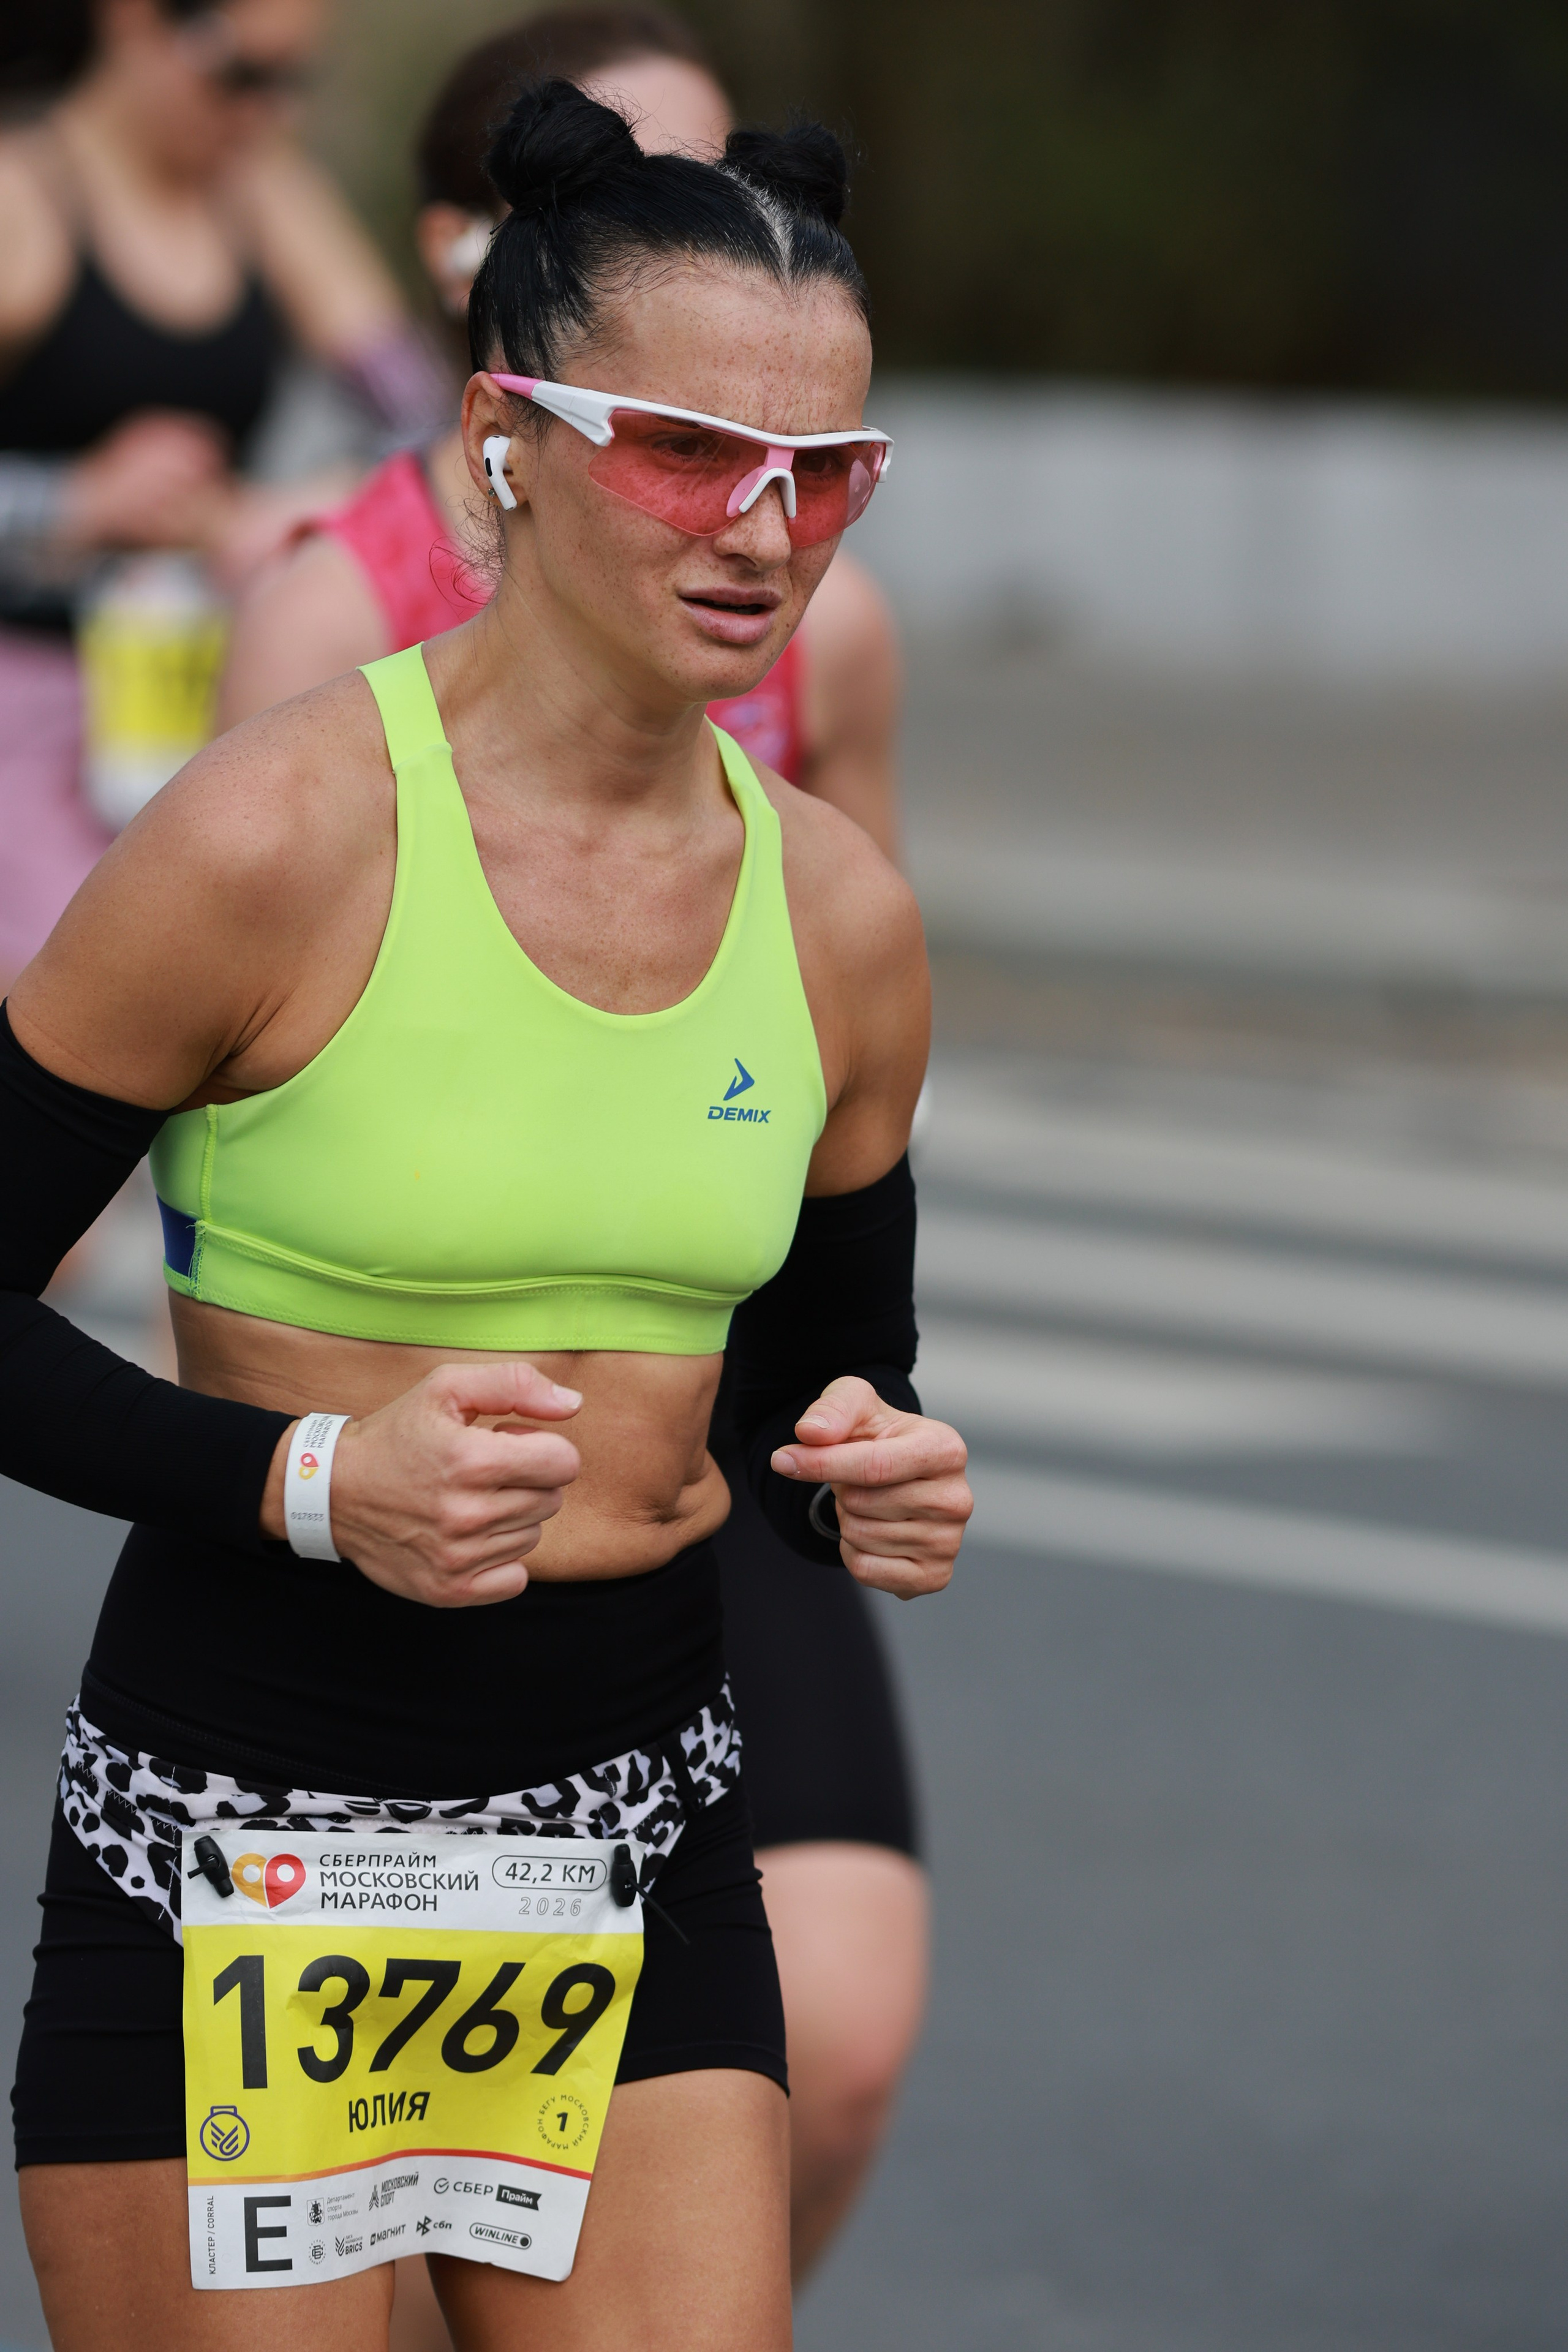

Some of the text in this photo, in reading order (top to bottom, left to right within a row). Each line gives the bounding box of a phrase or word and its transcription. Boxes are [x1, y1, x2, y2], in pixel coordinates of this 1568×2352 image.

[707, 1106, 772, 1123] DEMIX
[319, 1851, 437, 1868] СБЕРПРАЙМ
[320, 1870, 479, 1891] МОСКОВСКИЙ
[505, 1863, 596, 1885] 42,2 КМ
[320, 1891, 437, 1912] МАРАФОН
[518, 1896, 582, 1917] 2026
[213, 1954, 616, 2089] 13769
[349, 2091, 431, 2133] ЮЛИЯ
[537, 2094, 589, 2150] БЕГУ МОСКОВСКИЙ МАРАФОН
[556, 2111, 568, 2132] 1
[381, 2171, 419, 2193] МОСКОВСКИЙ
[380, 2191, 395, 2207] СПОРТ
[453, 2181, 533, 2205] СБЕР Прайм
[244, 2195, 293, 2273] E
[433, 2220, 453, 2230] сбп
[474, 2226, 519, 2244] WINLINE
[345, 2241, 363, 2255] BRICS
